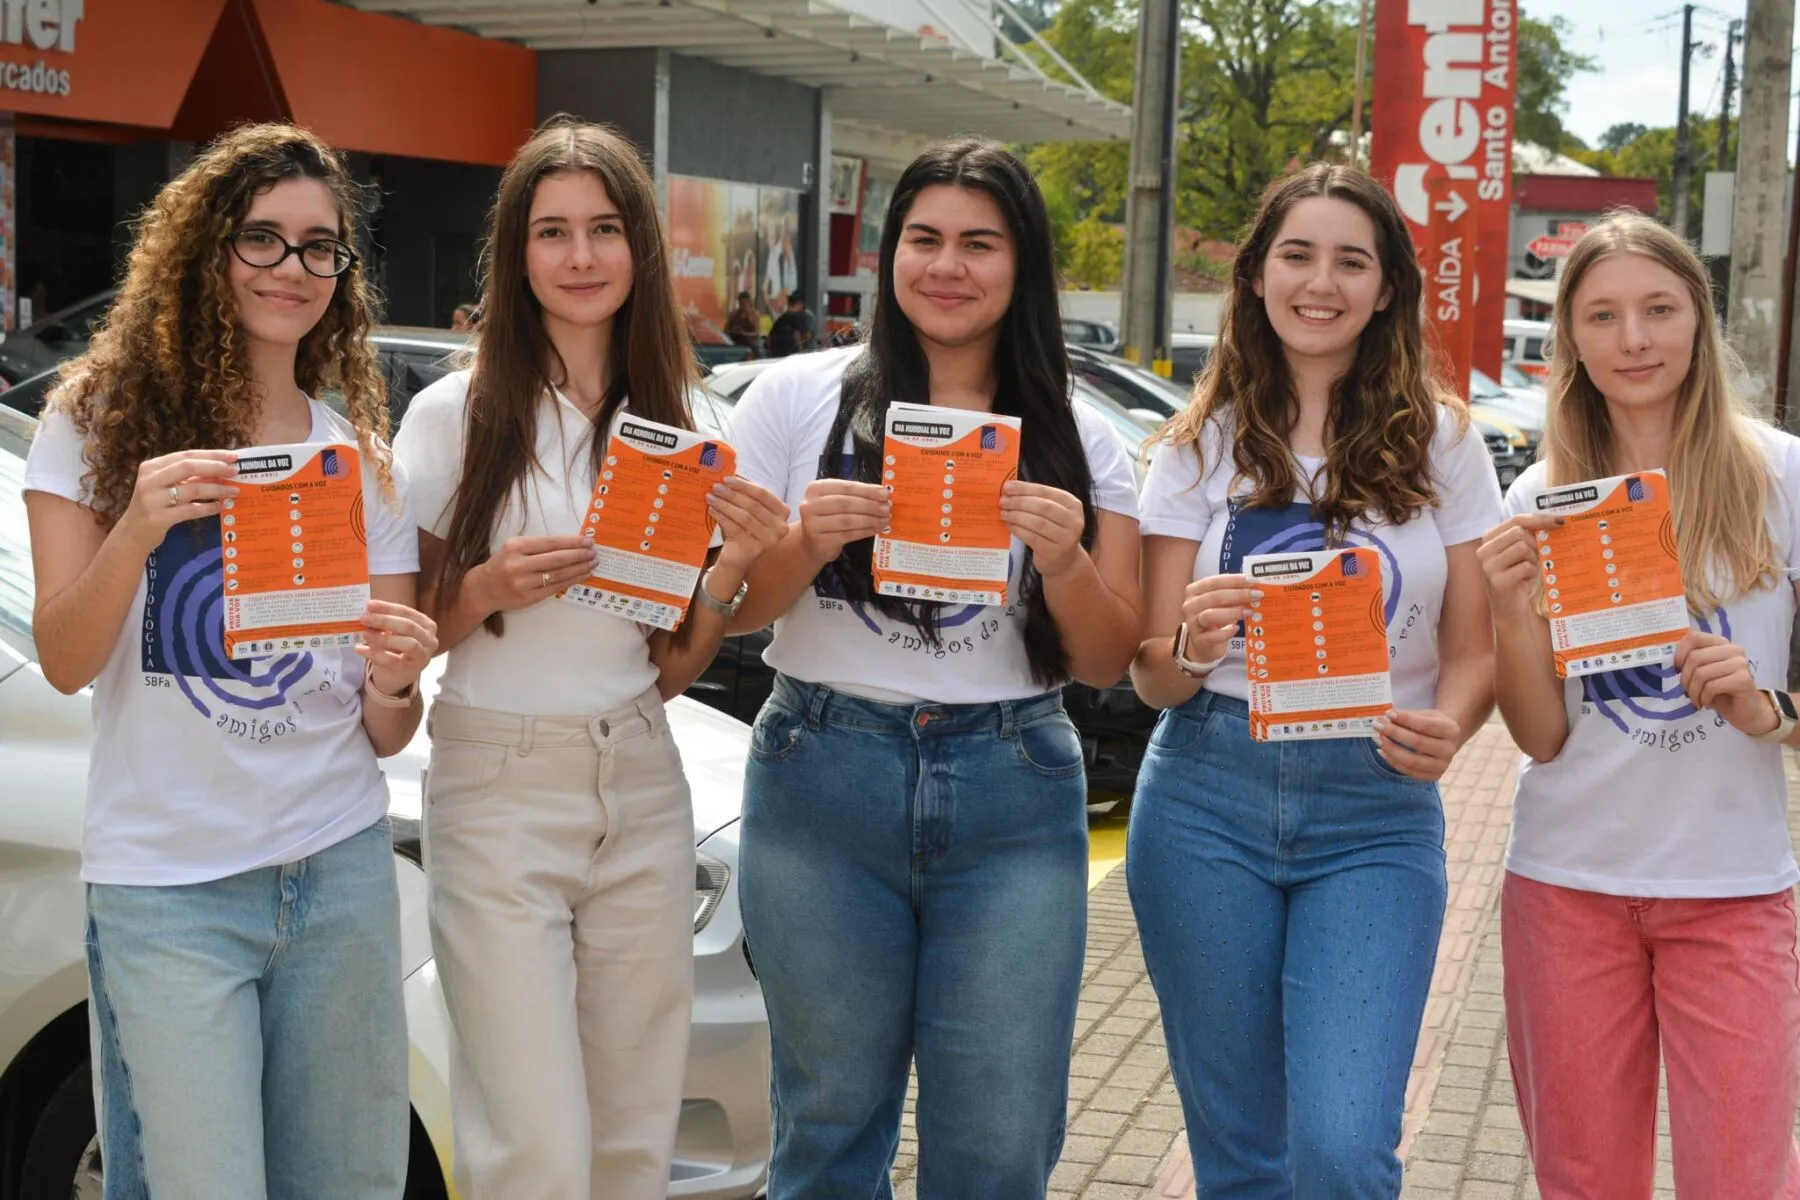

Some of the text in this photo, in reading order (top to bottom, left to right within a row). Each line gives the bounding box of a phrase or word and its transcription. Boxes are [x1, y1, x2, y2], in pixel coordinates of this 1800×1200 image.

[1478, 106, 1507, 201] Santo
[1435, 236, 1463, 322] SAÍDA
[623, 425, 634, 435] DIA
[656, 434, 665, 443] DA
[664, 436, 676, 446] VOZ
[894, 423, 905, 432] DIA
[930, 427, 939, 435] DA
[939, 427, 951, 436] VOZ
[267, 459, 277, 469] DA
[277, 458, 289, 467] VOZ
[1539, 497, 1549, 507] DIA
[1574, 492, 1583, 501] DA
[1583, 489, 1595, 499] VOZ
[1254, 565, 1265, 574] DIA
[1289, 562, 1298, 571] DA
[1298, 561, 1310, 570] VOZ
[146, 548, 157, 669] UDIOLOGIA
[819, 600, 844, 611] SBFa
[981, 620, 1000, 641] da
[145, 675, 171, 689] SBFa
[217, 714, 297, 743] amigos
[1631, 724, 1707, 752] amigos
